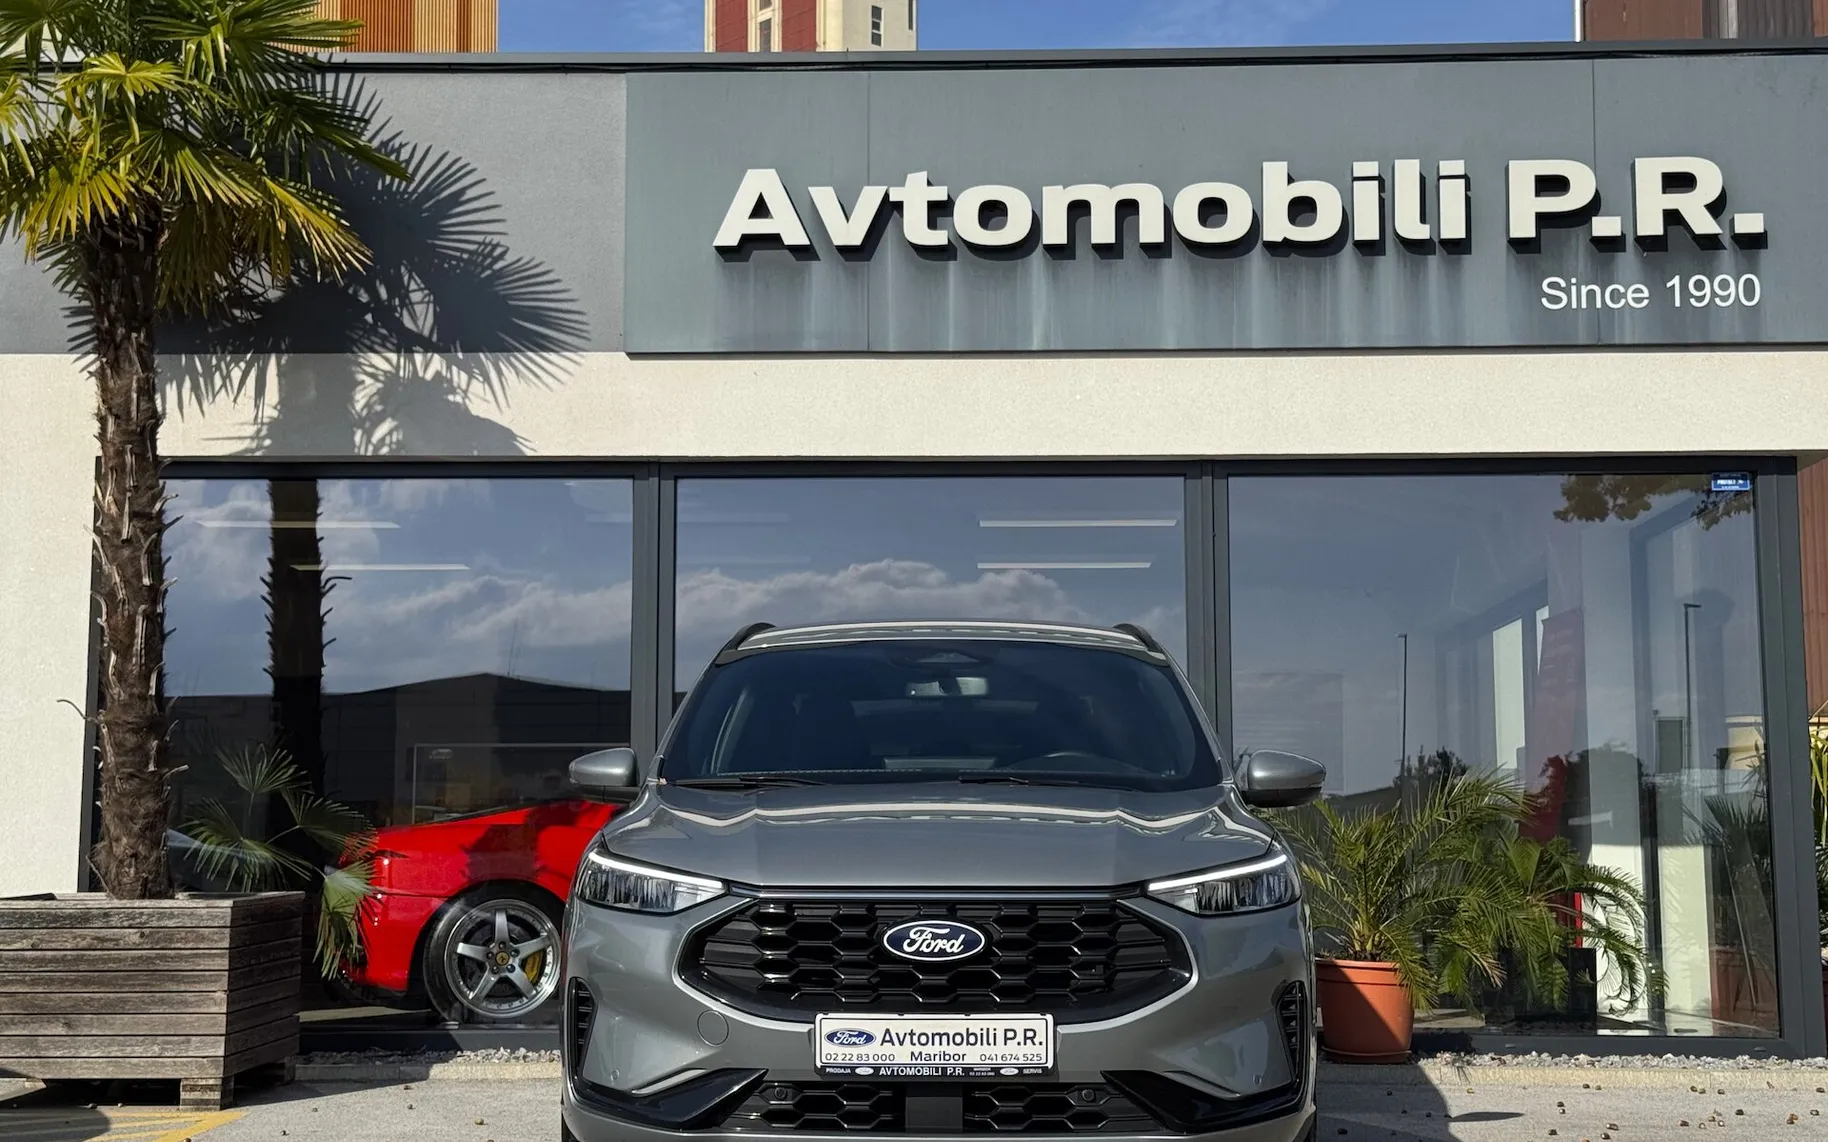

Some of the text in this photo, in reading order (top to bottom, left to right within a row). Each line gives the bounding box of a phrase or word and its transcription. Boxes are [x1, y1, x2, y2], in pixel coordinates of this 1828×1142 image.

[713, 156, 1765, 249] Avtomobili P.R.
[1541, 273, 1761, 310] Since 1990
[902, 926, 966, 953] Ford
[833, 1028, 1043, 1047] Ford Avtomobili P.R.
[825, 1051, 1043, 1062] 02 22 83 000 Maribor 041 674 525
[879, 1067, 942, 1076] AVTOMOBILI
[947, 1067, 965, 1076] P.R.
